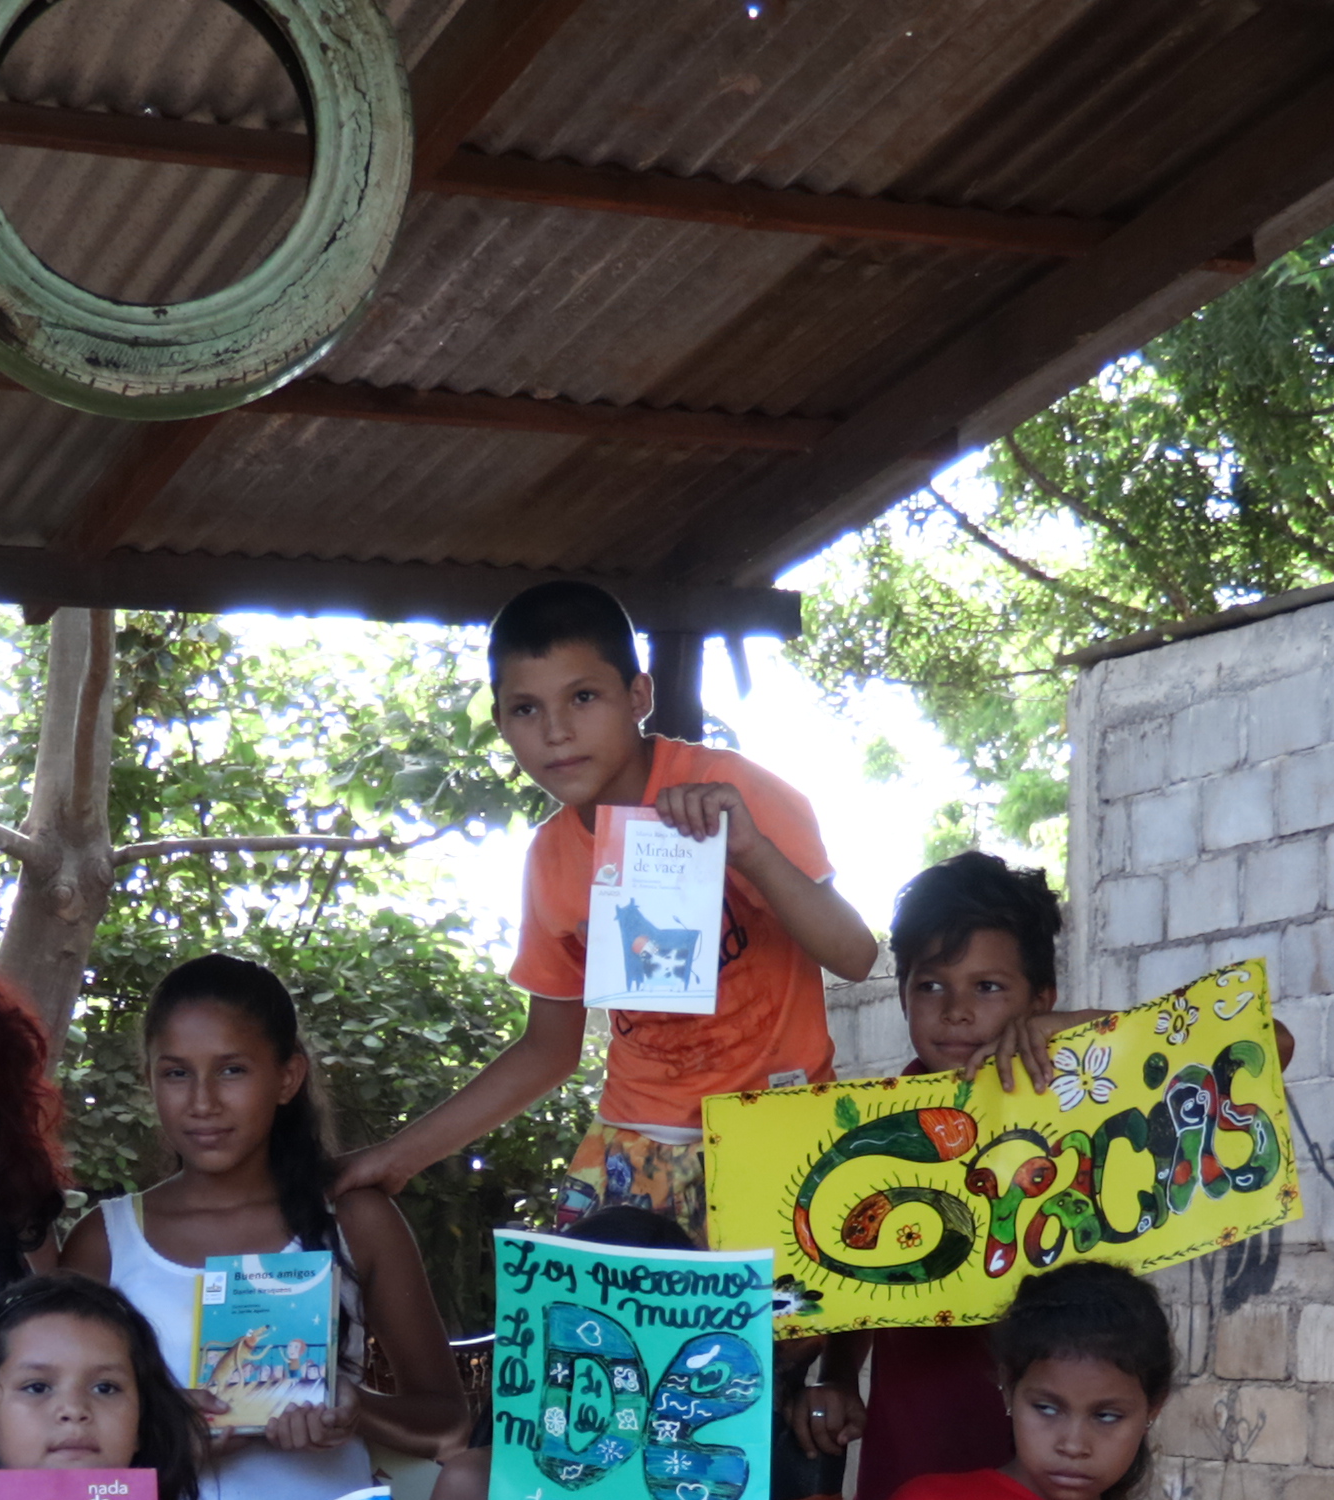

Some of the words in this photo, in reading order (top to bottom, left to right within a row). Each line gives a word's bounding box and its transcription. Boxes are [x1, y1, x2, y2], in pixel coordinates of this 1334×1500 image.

[635, 842, 693, 858] Miradas
[633, 859, 650, 872] de
[654, 863, 686, 874] vaca
[234, 1271, 274, 1281] Buenos
[276, 1268, 316, 1280] amigos
[88, 1479, 128, 1494] nada
